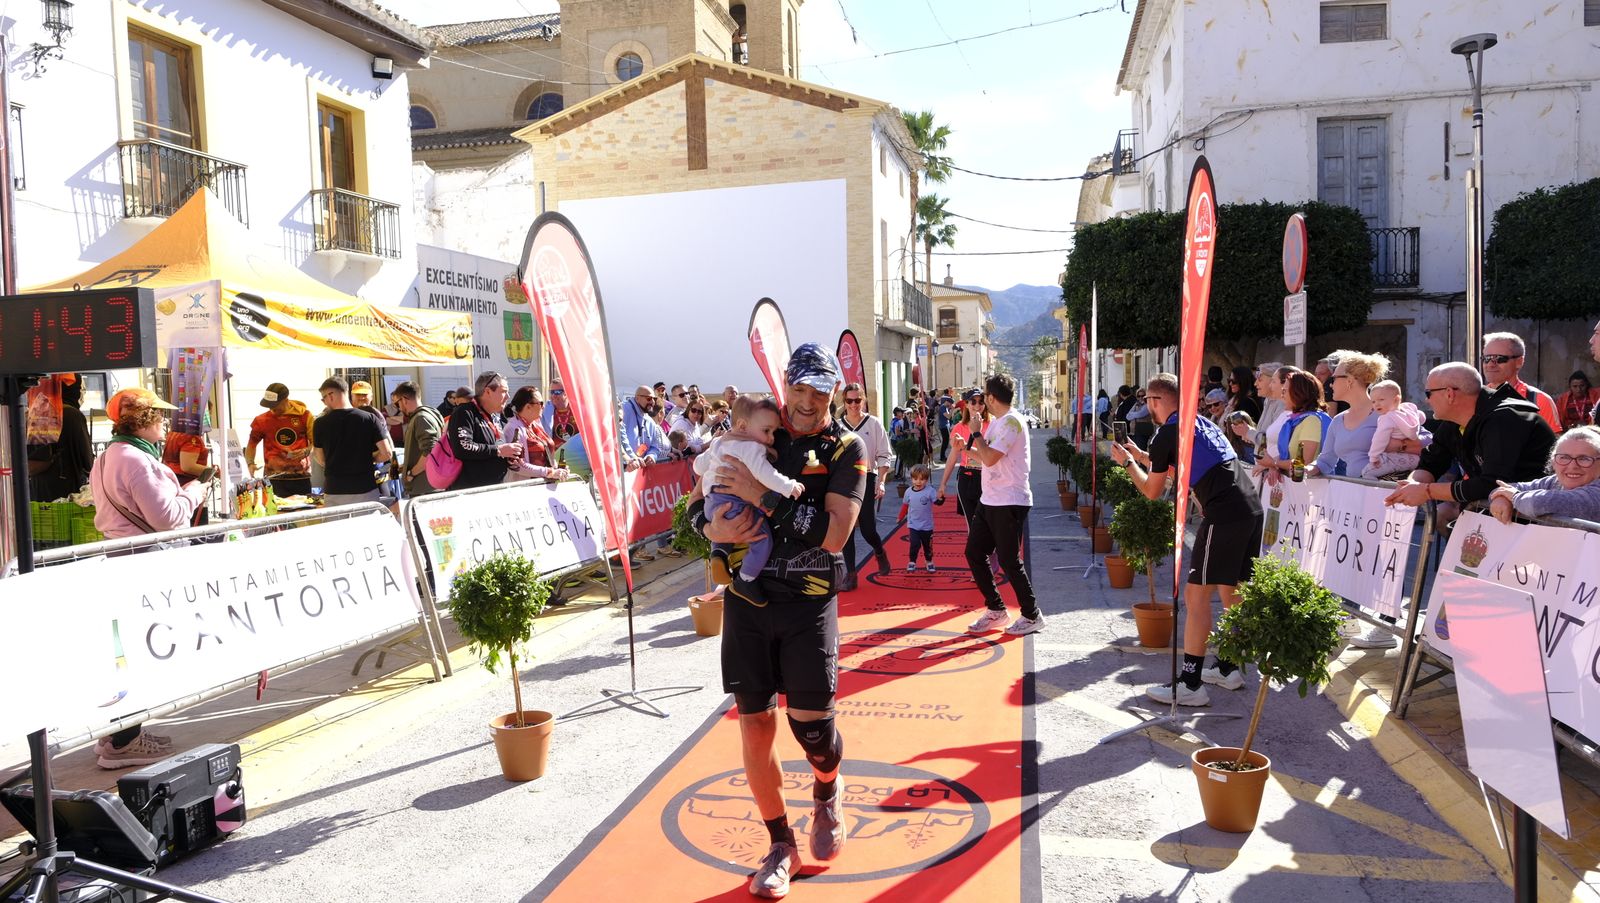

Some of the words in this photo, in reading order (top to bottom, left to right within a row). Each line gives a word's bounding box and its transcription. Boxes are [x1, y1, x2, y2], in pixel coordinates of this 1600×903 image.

[426, 267, 498, 293] EXCELENTÍSIMO
[428, 293, 497, 315] AYUNTAMIENTO
[0, 297, 134, 360] 1:43
[472, 344, 490, 360] ORIA
[632, 481, 683, 518] VEOLIA
[472, 515, 595, 564] CANTORIA
[1385, 521, 1400, 540] DE
[142, 549, 355, 611] AYUNTAMIENTO
[364, 543, 387, 562] DE
[146, 565, 401, 661] CANTORIA
[834, 709, 964, 722] Ayuntami
[838, 700, 912, 710] Canto
[919, 703, 951, 711] de
[906, 787, 951, 799] LA
